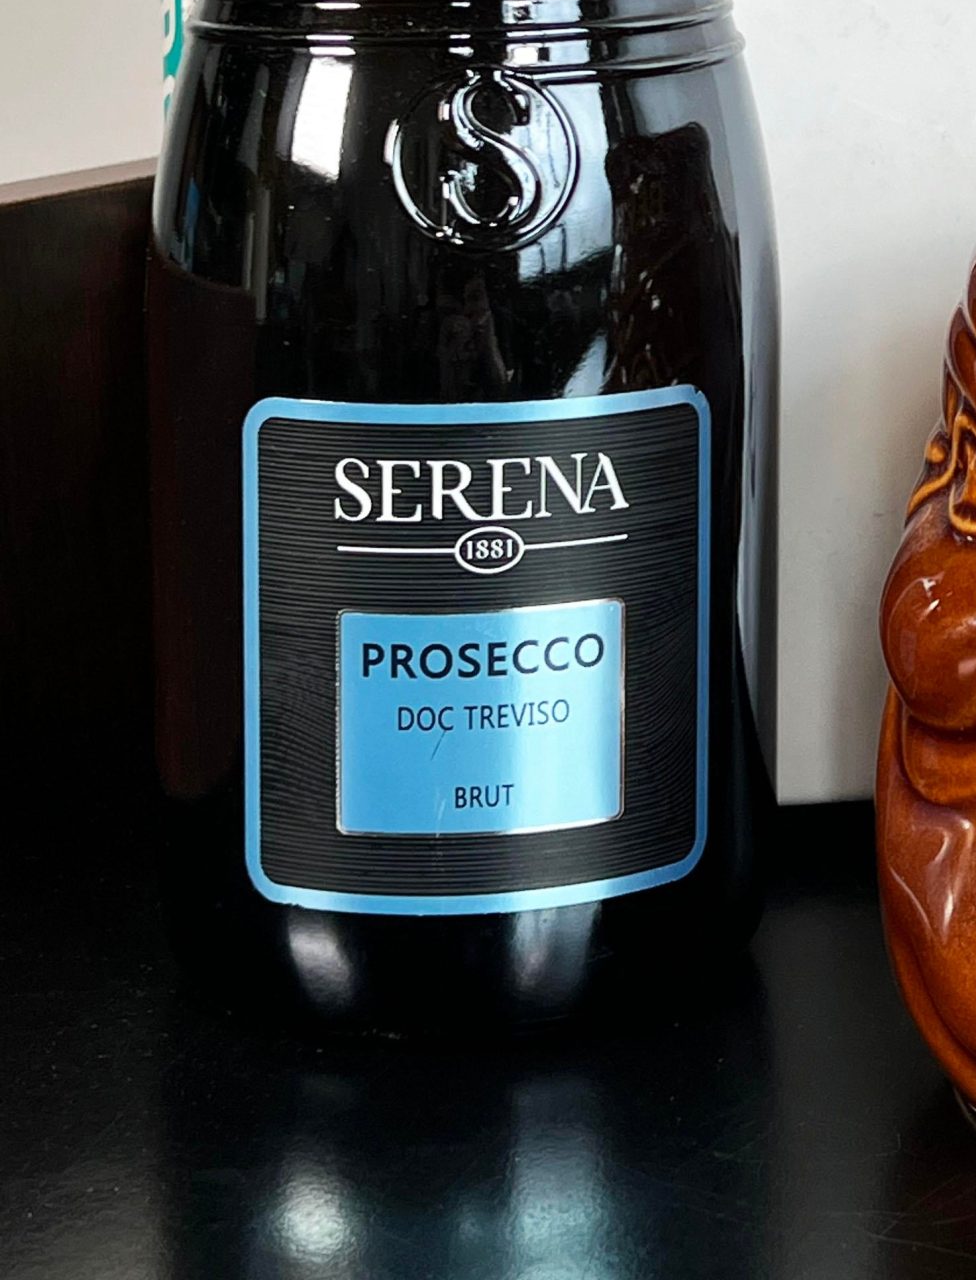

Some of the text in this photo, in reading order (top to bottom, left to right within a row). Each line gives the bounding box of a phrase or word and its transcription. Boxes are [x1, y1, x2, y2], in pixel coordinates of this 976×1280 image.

[334, 452, 630, 522] SERENA
[465, 538, 514, 560] 1881
[361, 633, 605, 679] PROSECCO
[397, 698, 570, 732] DOC TREVISO
[454, 784, 515, 809] BRUT
